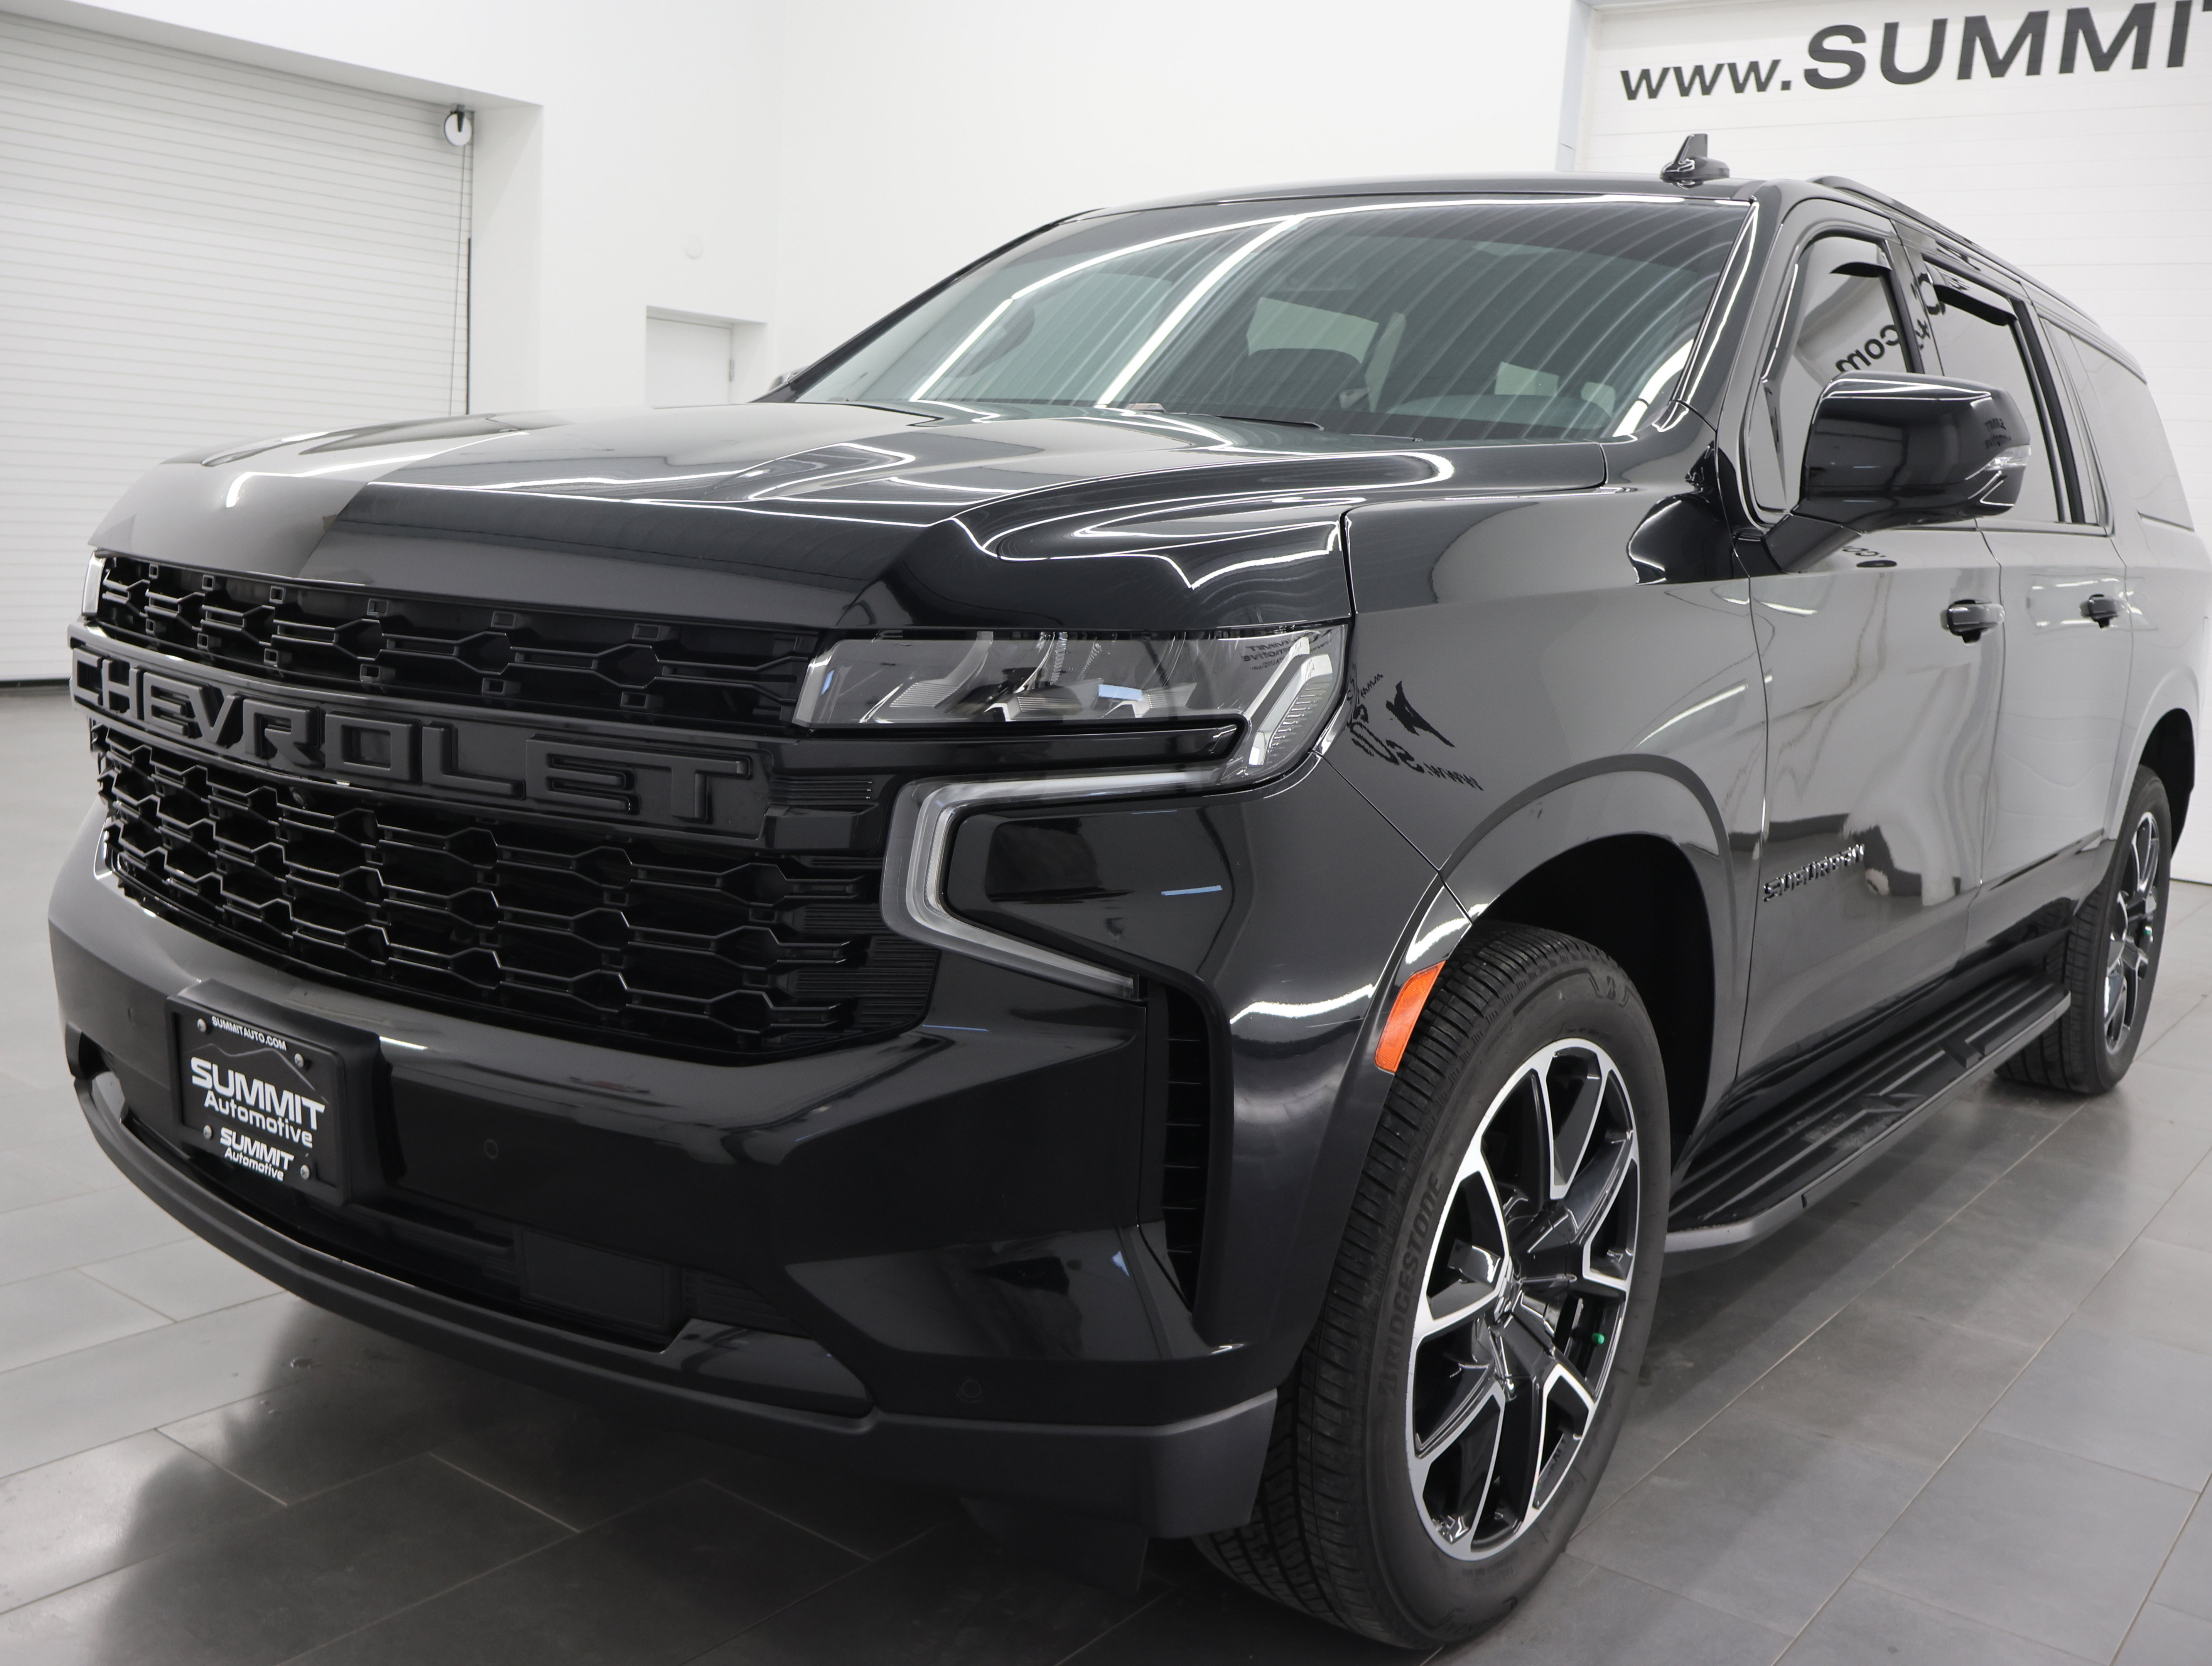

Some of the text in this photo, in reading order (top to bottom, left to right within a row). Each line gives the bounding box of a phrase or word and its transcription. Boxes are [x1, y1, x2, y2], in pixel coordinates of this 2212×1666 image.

[1620, 0, 2212, 101] www.SUMMI
[71, 648, 751, 822] CHEVROLET
[1762, 843, 1864, 902] SUBURBAN
[211, 1015, 287, 1051] SUMMITAUTO.COM
[191, 1057, 325, 1130] SUMMIT
[204, 1090, 313, 1148] Automotive
[220, 1126, 294, 1170] SUMMIT
[224, 1147, 284, 1181] Automotive
[1378, 1171, 1443, 1396] BRIDGESTONE
